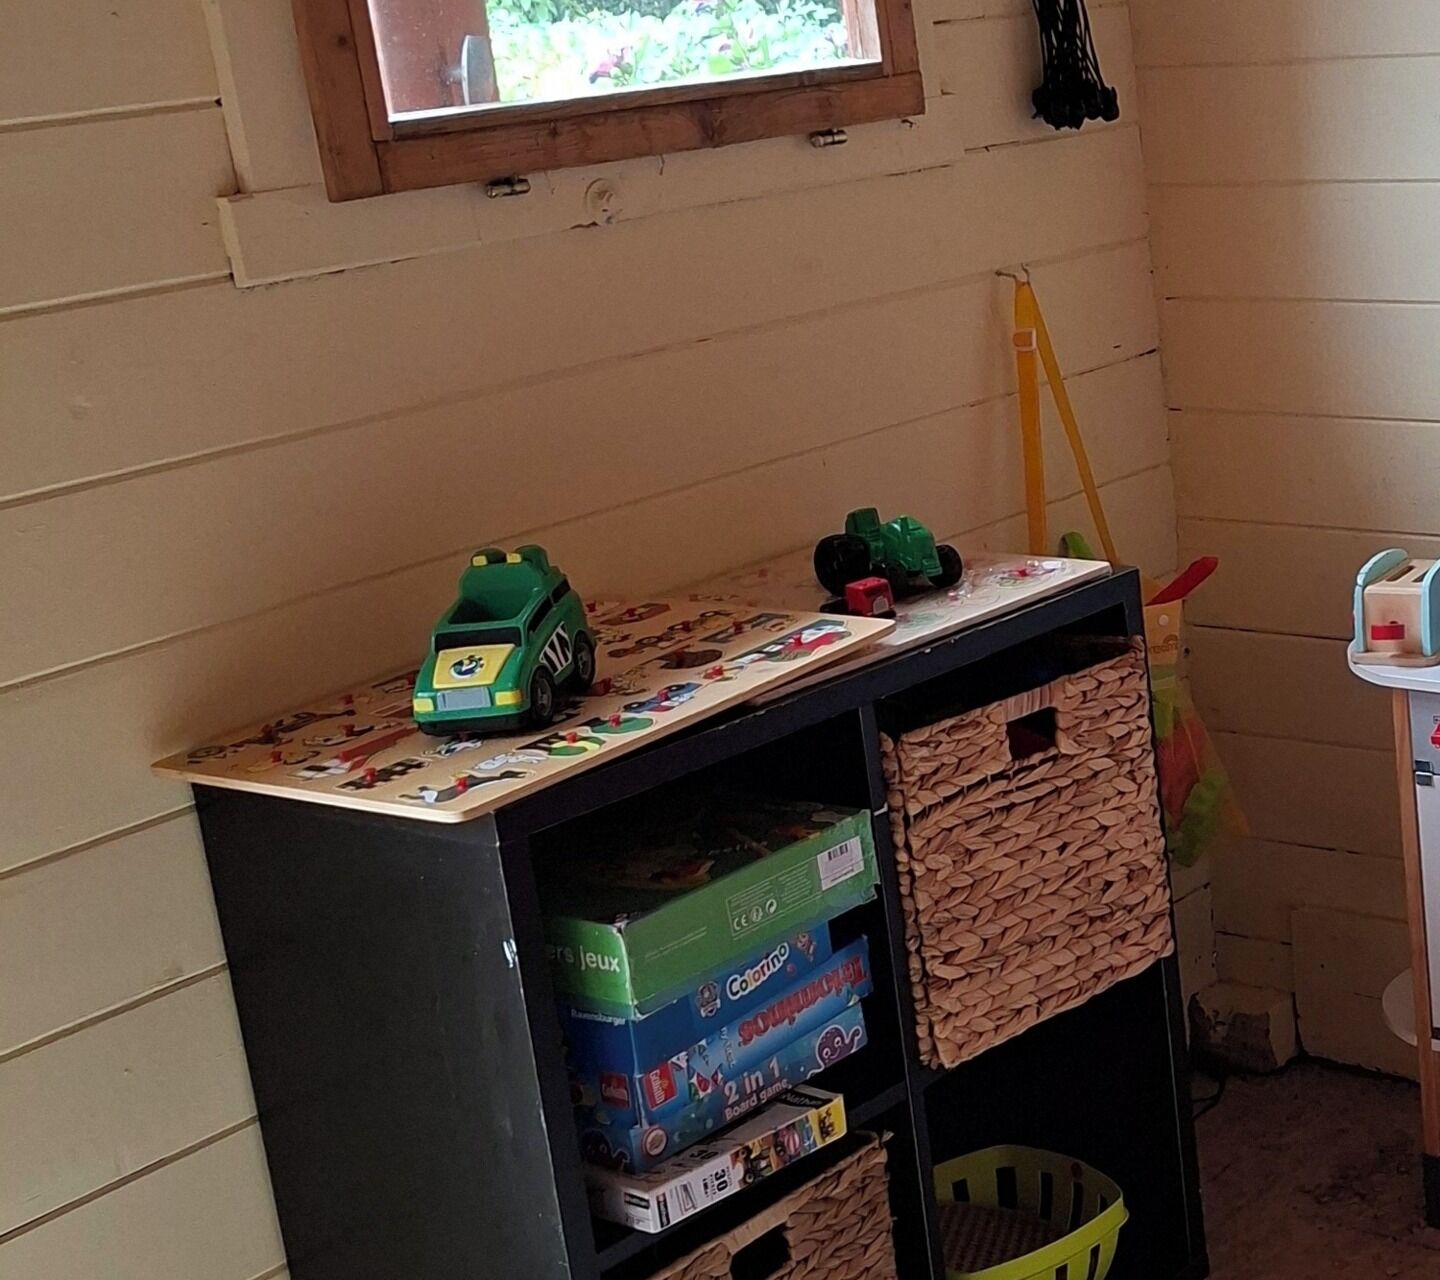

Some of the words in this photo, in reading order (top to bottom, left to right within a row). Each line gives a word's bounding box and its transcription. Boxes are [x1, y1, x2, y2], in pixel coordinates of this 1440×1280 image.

[579, 945, 621, 973] jeux
[727, 941, 790, 1001] Colorino
[724, 1081, 740, 1106] 2
[743, 1070, 764, 1094] in
[769, 1055, 781, 1079] 1
[725, 1095, 758, 1121] Board
[714, 1168, 728, 1193] 30
